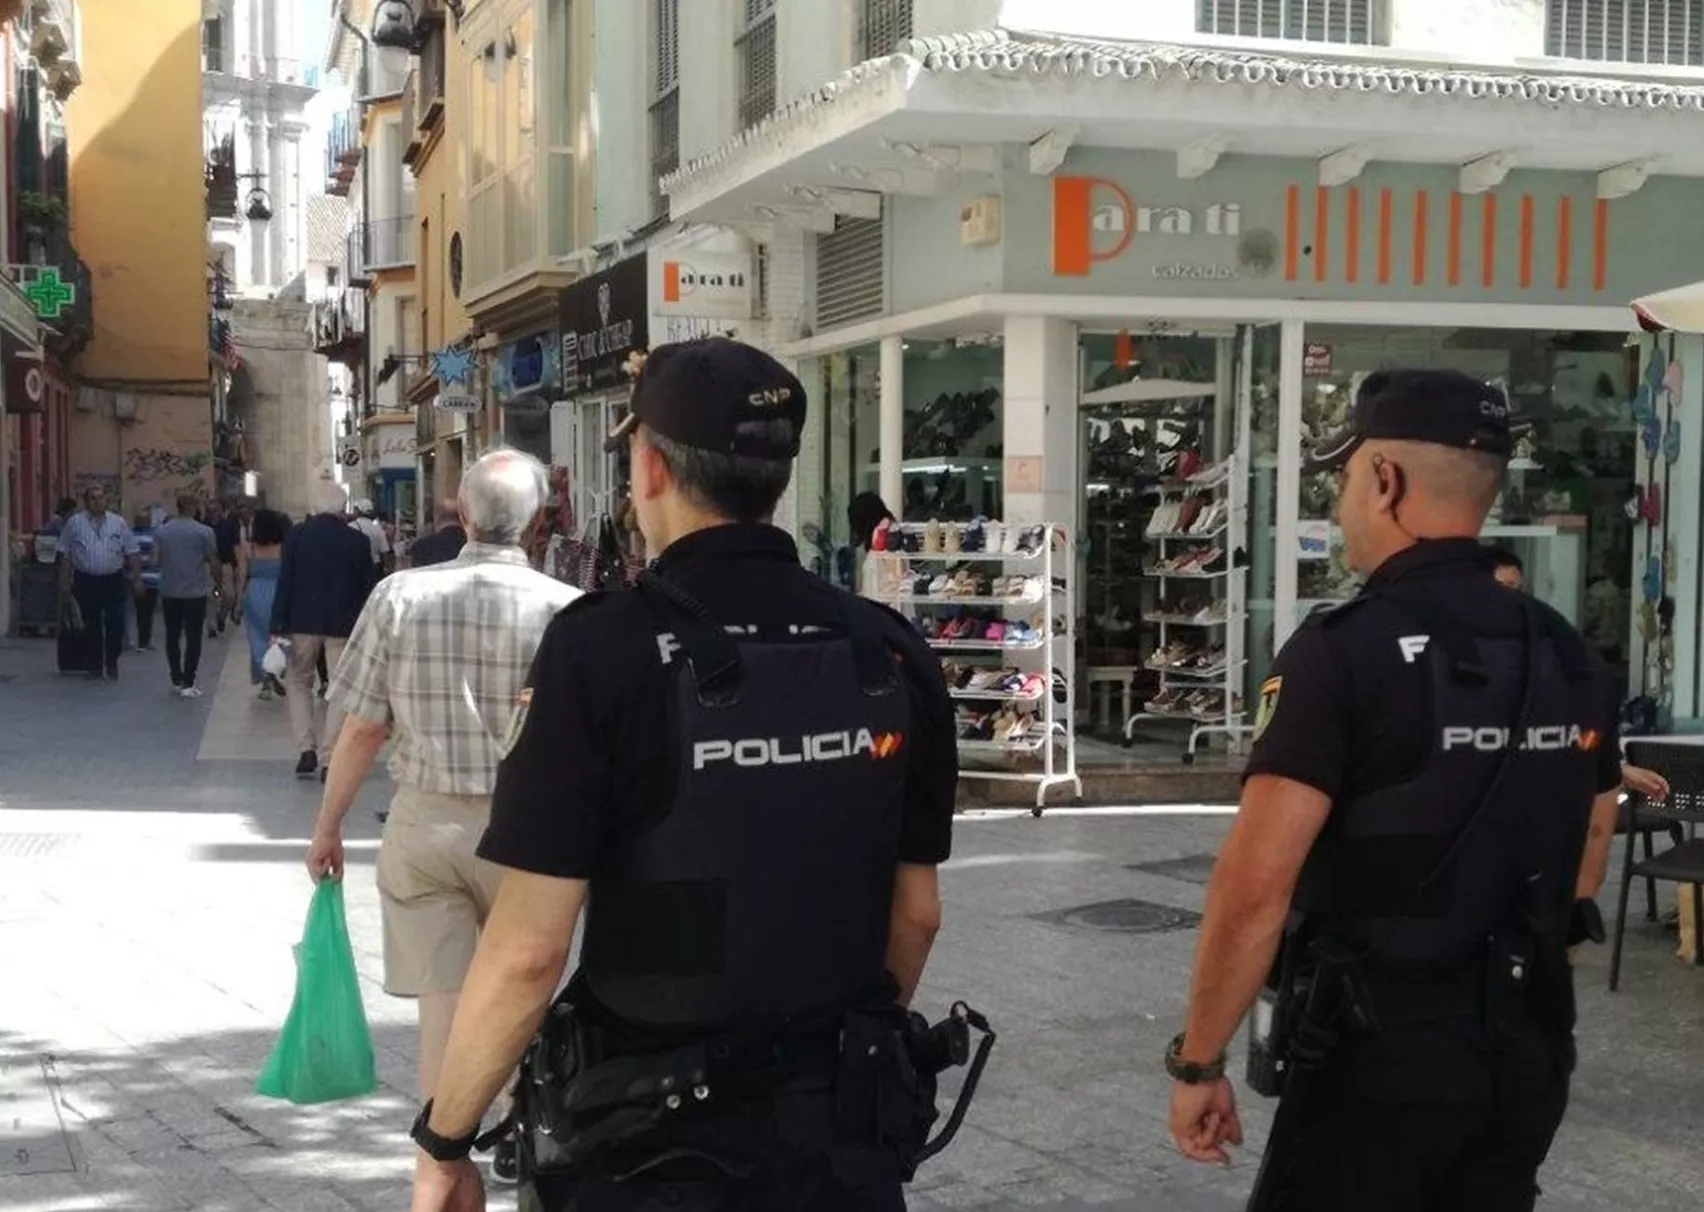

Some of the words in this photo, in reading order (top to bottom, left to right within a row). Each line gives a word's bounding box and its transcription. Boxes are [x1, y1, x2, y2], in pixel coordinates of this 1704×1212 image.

[1053, 176, 1192, 277] Para
[1205, 203, 1241, 236] ti
[747, 388, 791, 407] CNP
[693, 727, 876, 770] POLICIA
